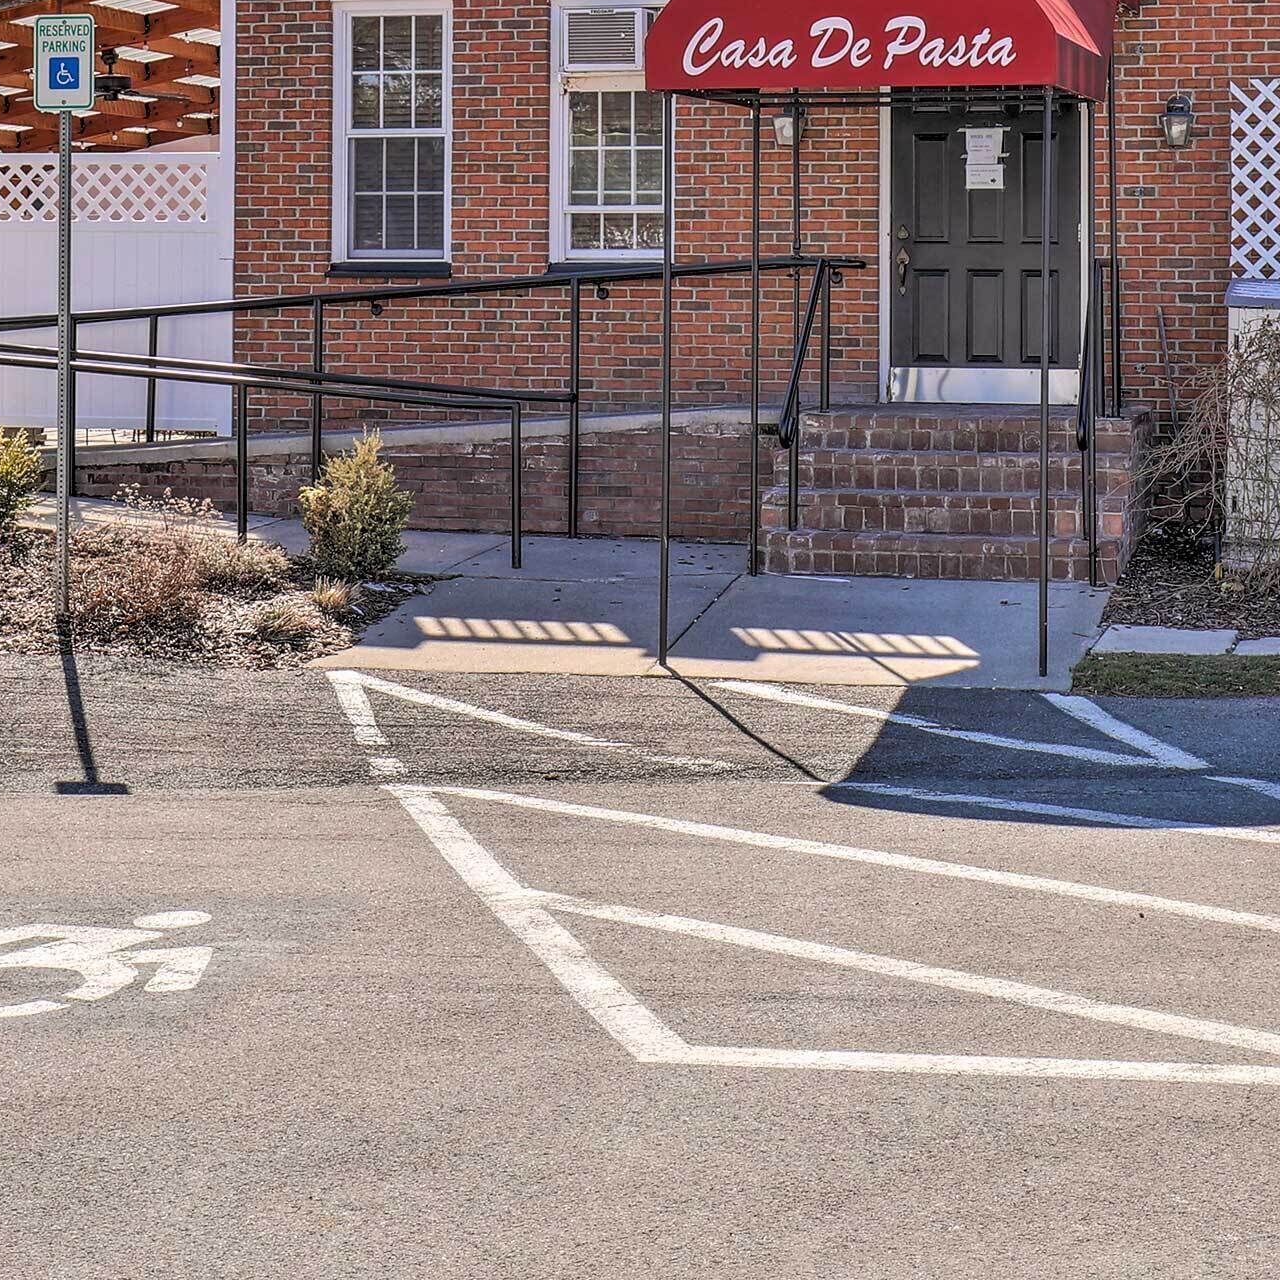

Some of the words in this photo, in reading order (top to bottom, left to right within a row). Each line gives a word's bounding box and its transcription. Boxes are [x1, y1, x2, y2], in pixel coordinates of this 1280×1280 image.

[39, 24, 90, 37] RESERVED
[42, 40, 86, 53] PARKING
[682, 17, 797, 76] Casa
[810, 16, 871, 68] De
[883, 15, 1016, 70] Pasta
